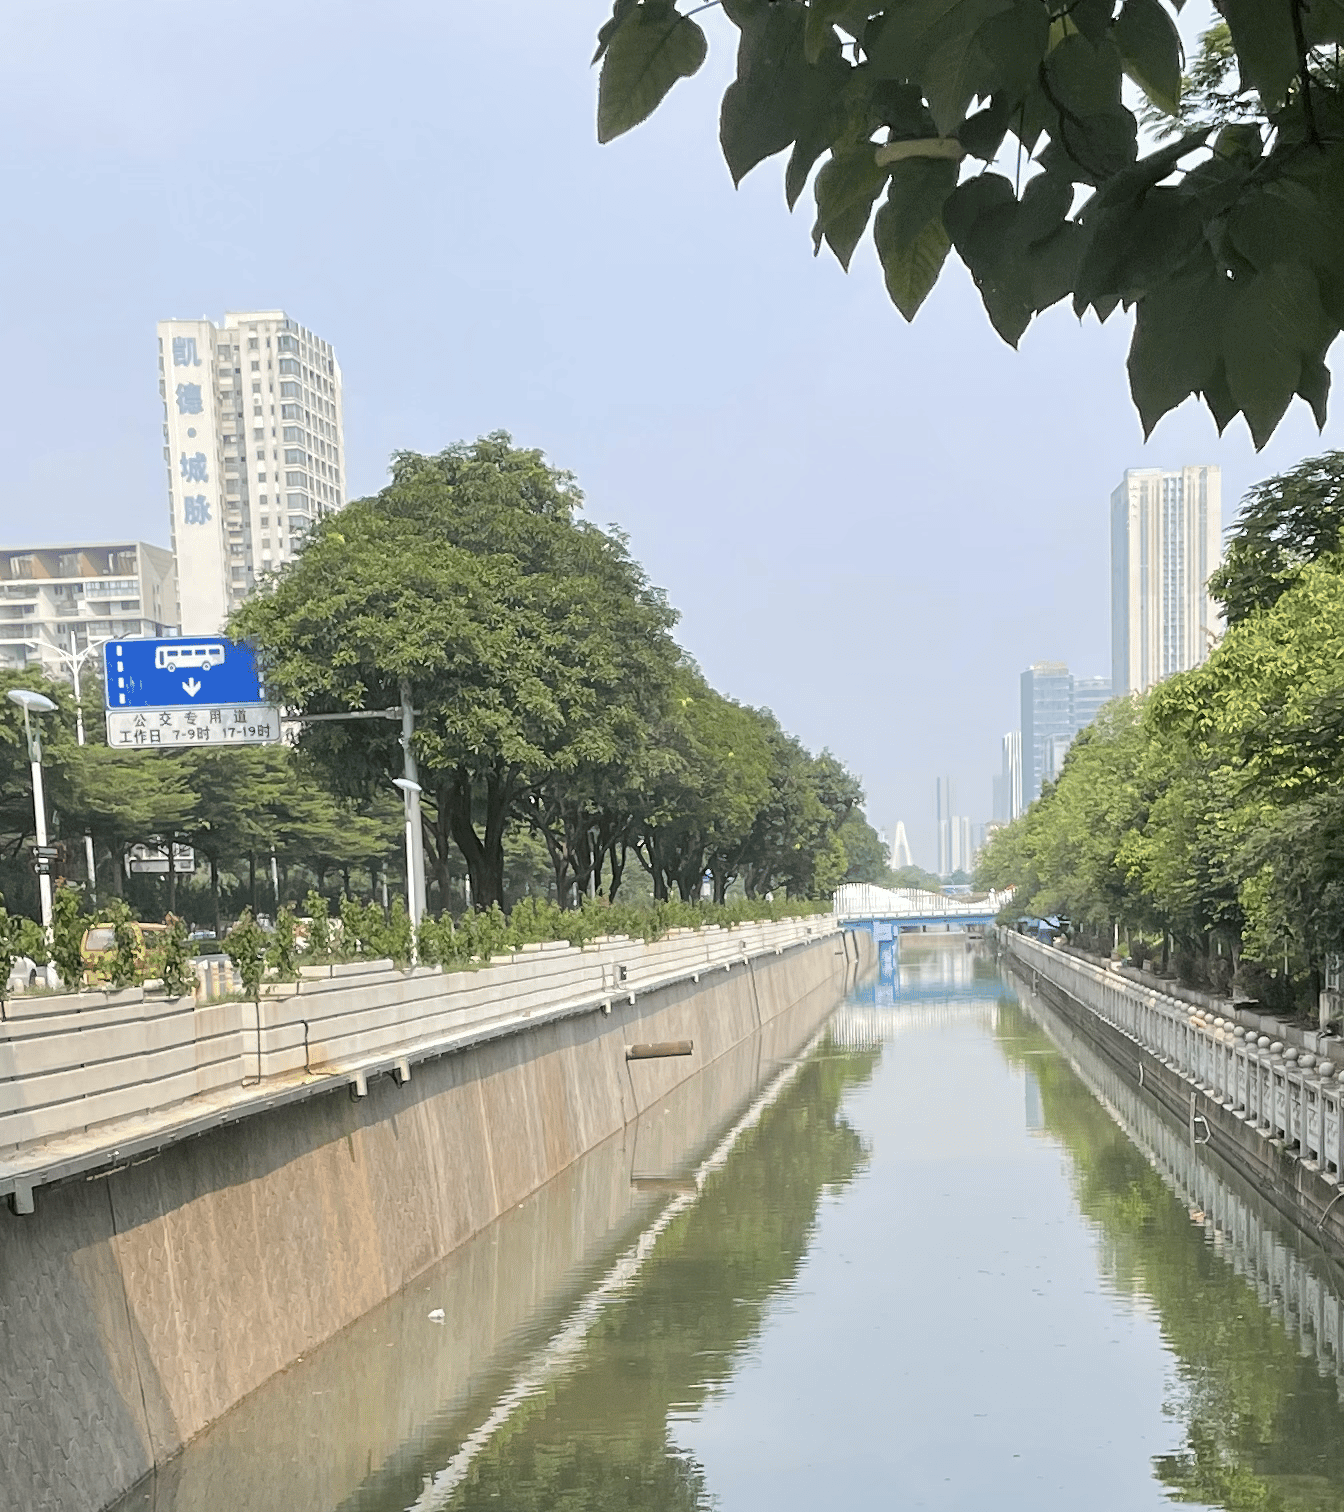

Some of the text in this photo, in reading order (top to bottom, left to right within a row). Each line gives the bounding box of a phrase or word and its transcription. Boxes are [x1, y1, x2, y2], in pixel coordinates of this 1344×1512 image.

[133, 709, 247, 727] 公交专用道
[119, 723, 270, 744] 工作日 7-9时 17-19时
